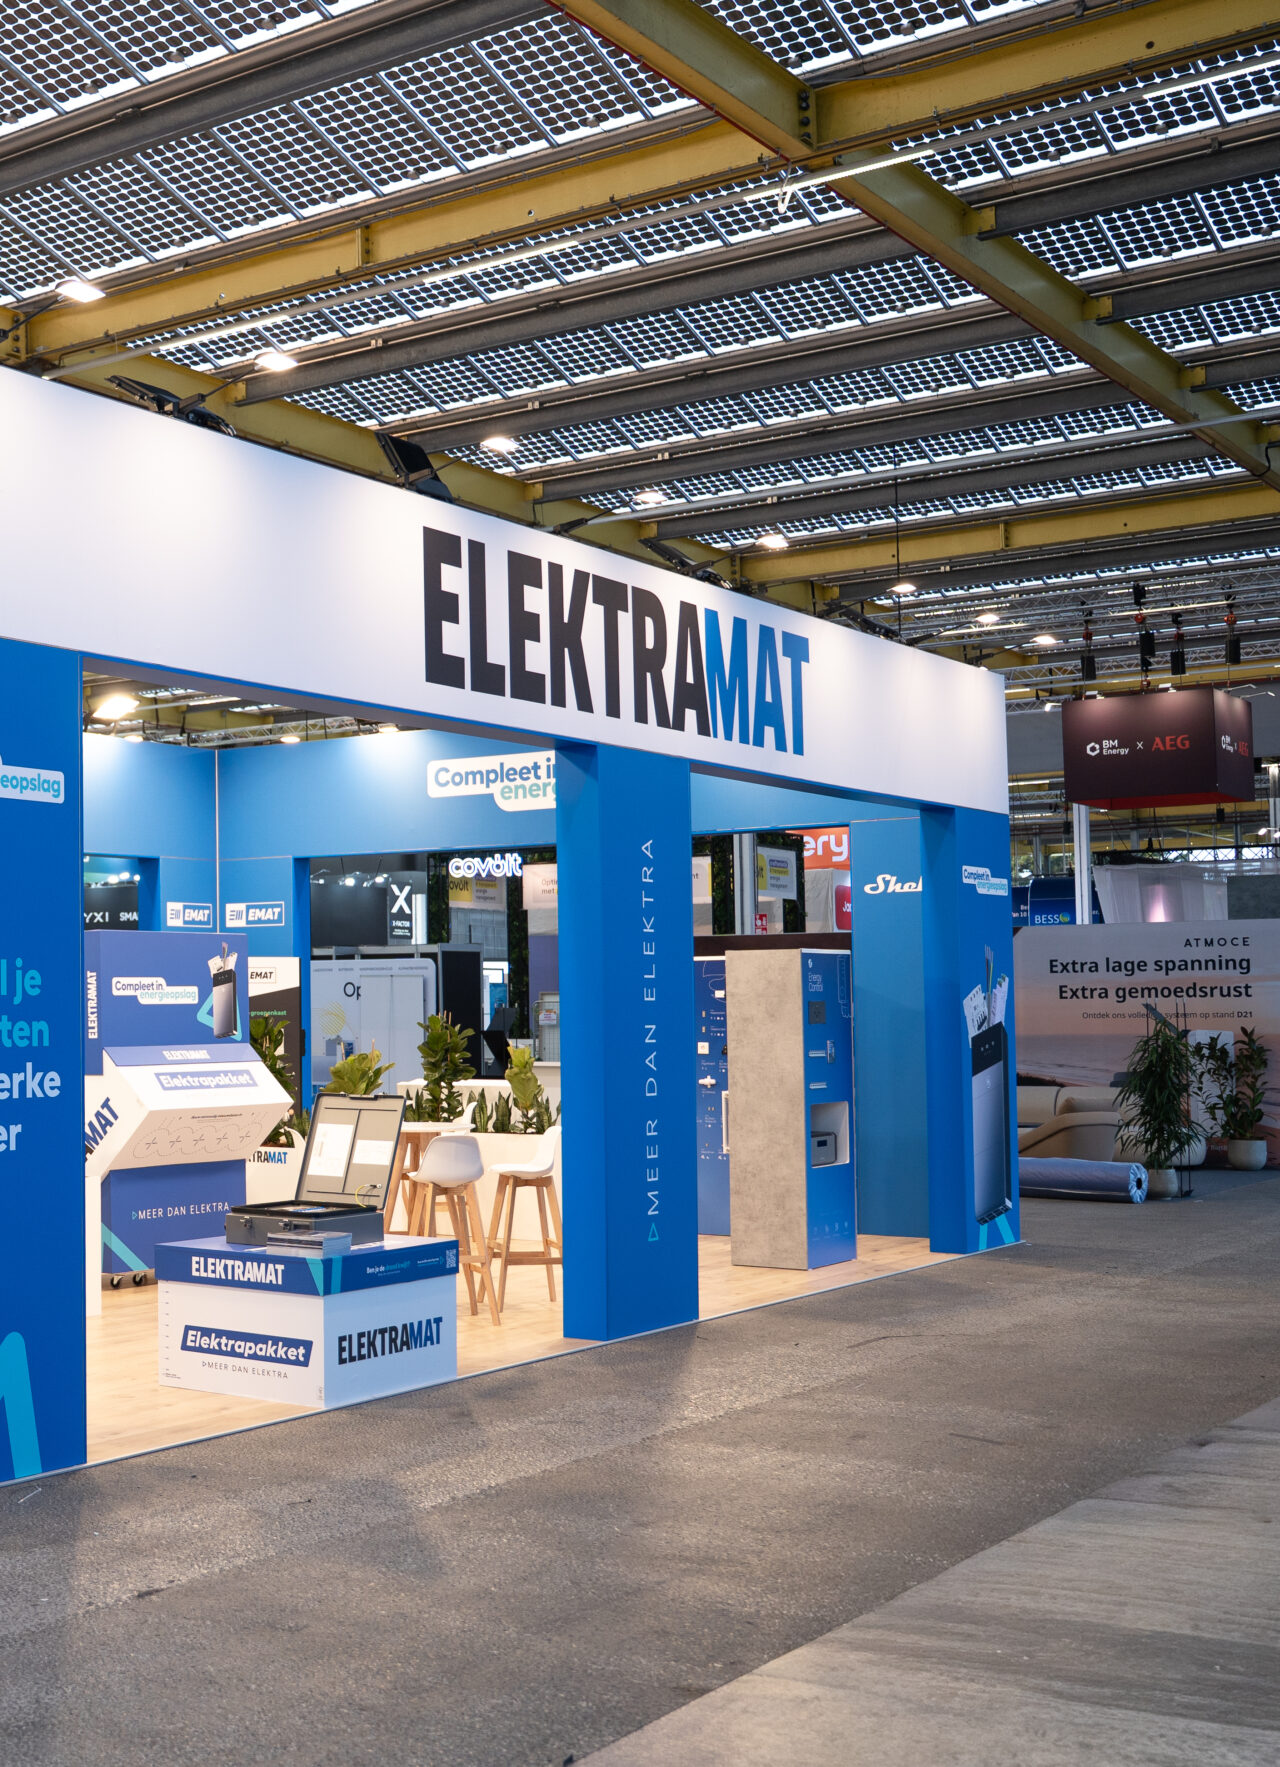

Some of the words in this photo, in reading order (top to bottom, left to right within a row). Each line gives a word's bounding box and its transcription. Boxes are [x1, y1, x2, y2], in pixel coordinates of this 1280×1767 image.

[423, 526, 809, 756] ELEKTRAMAT
[1103, 739, 1118, 748] BM
[1152, 735, 1190, 752] AEG
[1103, 747, 1129, 756] Energy
[434, 761, 541, 788] Compleet
[804, 834, 849, 862] ery
[390, 884, 411, 914] X
[184, 908, 210, 921] EMAT
[248, 908, 281, 921] EMAT
[641, 839, 656, 1001] ELEKTRA
[1034, 914, 1059, 924] BESS
[1184, 936, 1250, 947] ATMOCE
[1049, 959, 1099, 973] Extra
[1105, 957, 1148, 976] lage
[1154, 955, 1251, 975] spanning
[13, 957, 42, 1005] je
[250, 971, 273, 980] EMAT
[114, 980, 154, 992] Compleet
[155, 980, 164, 991] in
[140, 989, 197, 1002] energieopslag
[1058, 985, 1109, 999] Extra
[1115, 982, 1252, 1003] gemoedsrust
[87, 971, 98, 1039] ELEKTRAMAT
[1082, 1011, 1109, 1019] Ontdek
[1199, 1012, 1210, 1020] op
[1212, 1011, 1234, 1019] stand
[645, 1024, 658, 1097] DAN
[159, 1073, 253, 1088] Elektrapakket
[248, 1151, 288, 1165] TRAMAT
[646, 1118, 659, 1215] MEER
[138, 1208, 164, 1220] MEER
[167, 1205, 186, 1217] DAN
[190, 1202, 229, 1215] ELEKTRA
[191, 1256, 285, 1286] ELEKTRAMAT
[186, 1330, 306, 1362] Elektrapakket
[338, 1316, 443, 1366] ELEKTRAMAT
[207, 1362, 228, 1371] MEER
[232, 1364, 249, 1374] DAN
[252, 1367, 288, 1380] ELEKTRA
